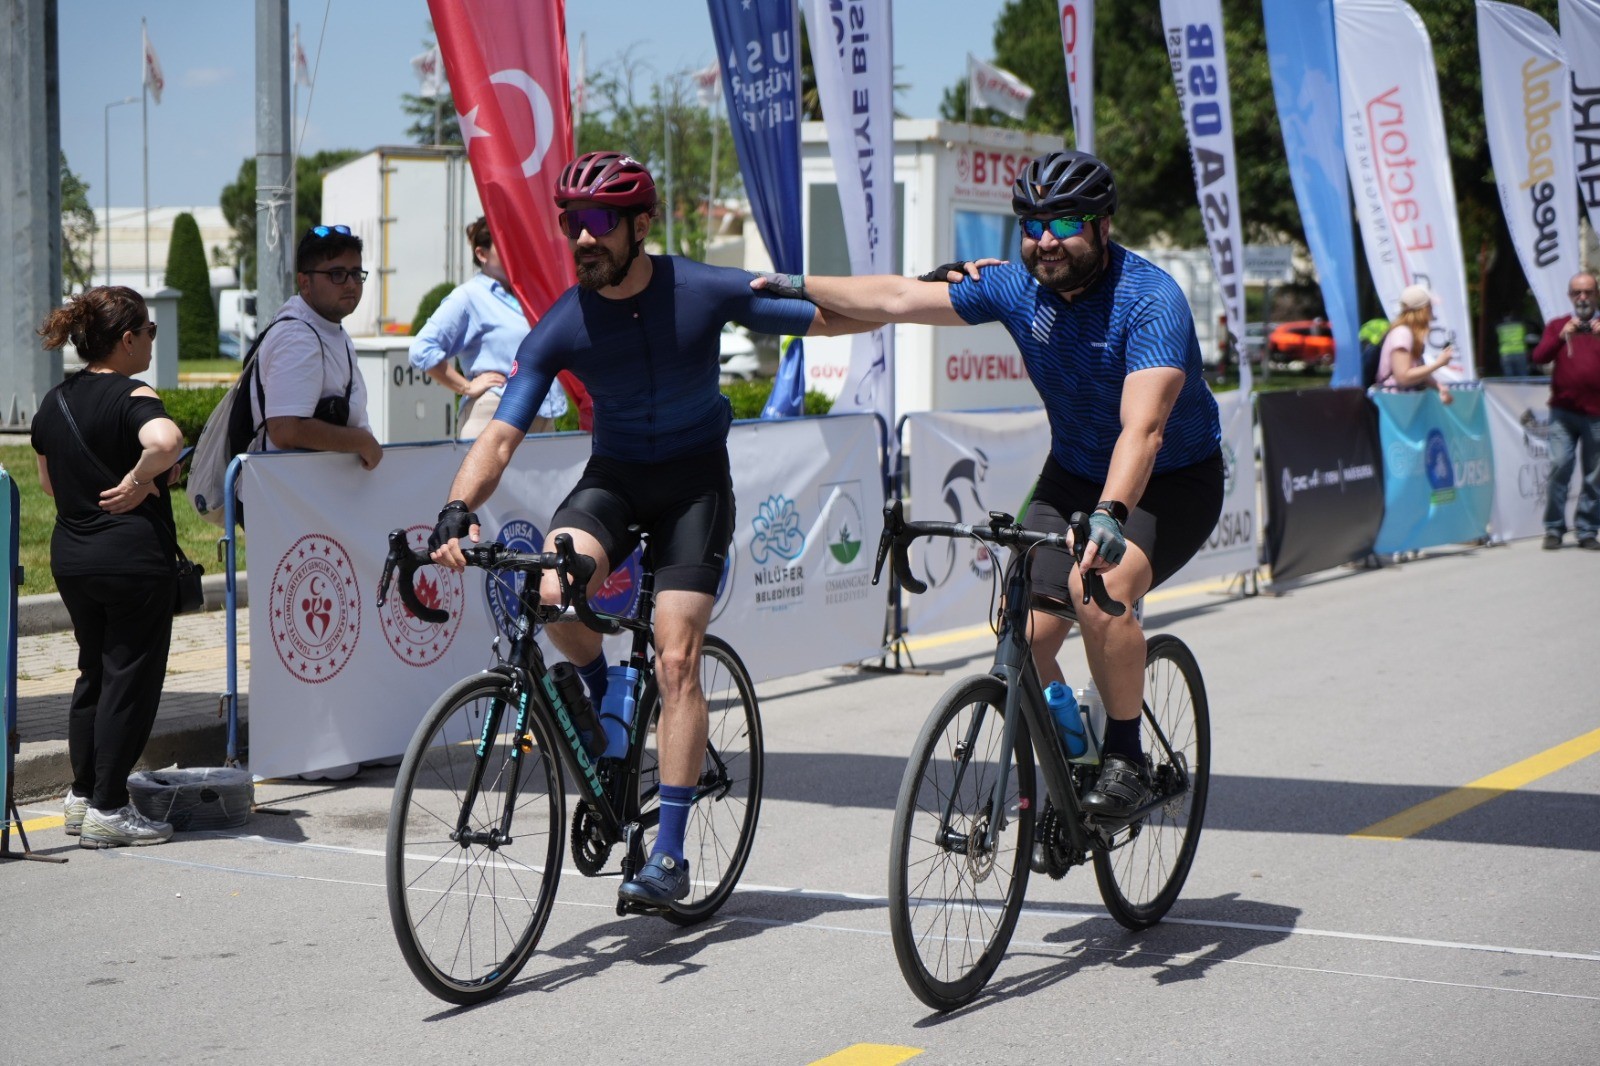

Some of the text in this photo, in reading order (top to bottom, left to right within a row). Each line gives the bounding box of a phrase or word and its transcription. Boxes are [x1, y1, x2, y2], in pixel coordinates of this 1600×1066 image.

[810, 364, 849, 380] GÜV
[503, 522, 534, 541] BURSA
[754, 565, 804, 587] NİLÜFER
[755, 583, 804, 604] BELEDİYESİ
